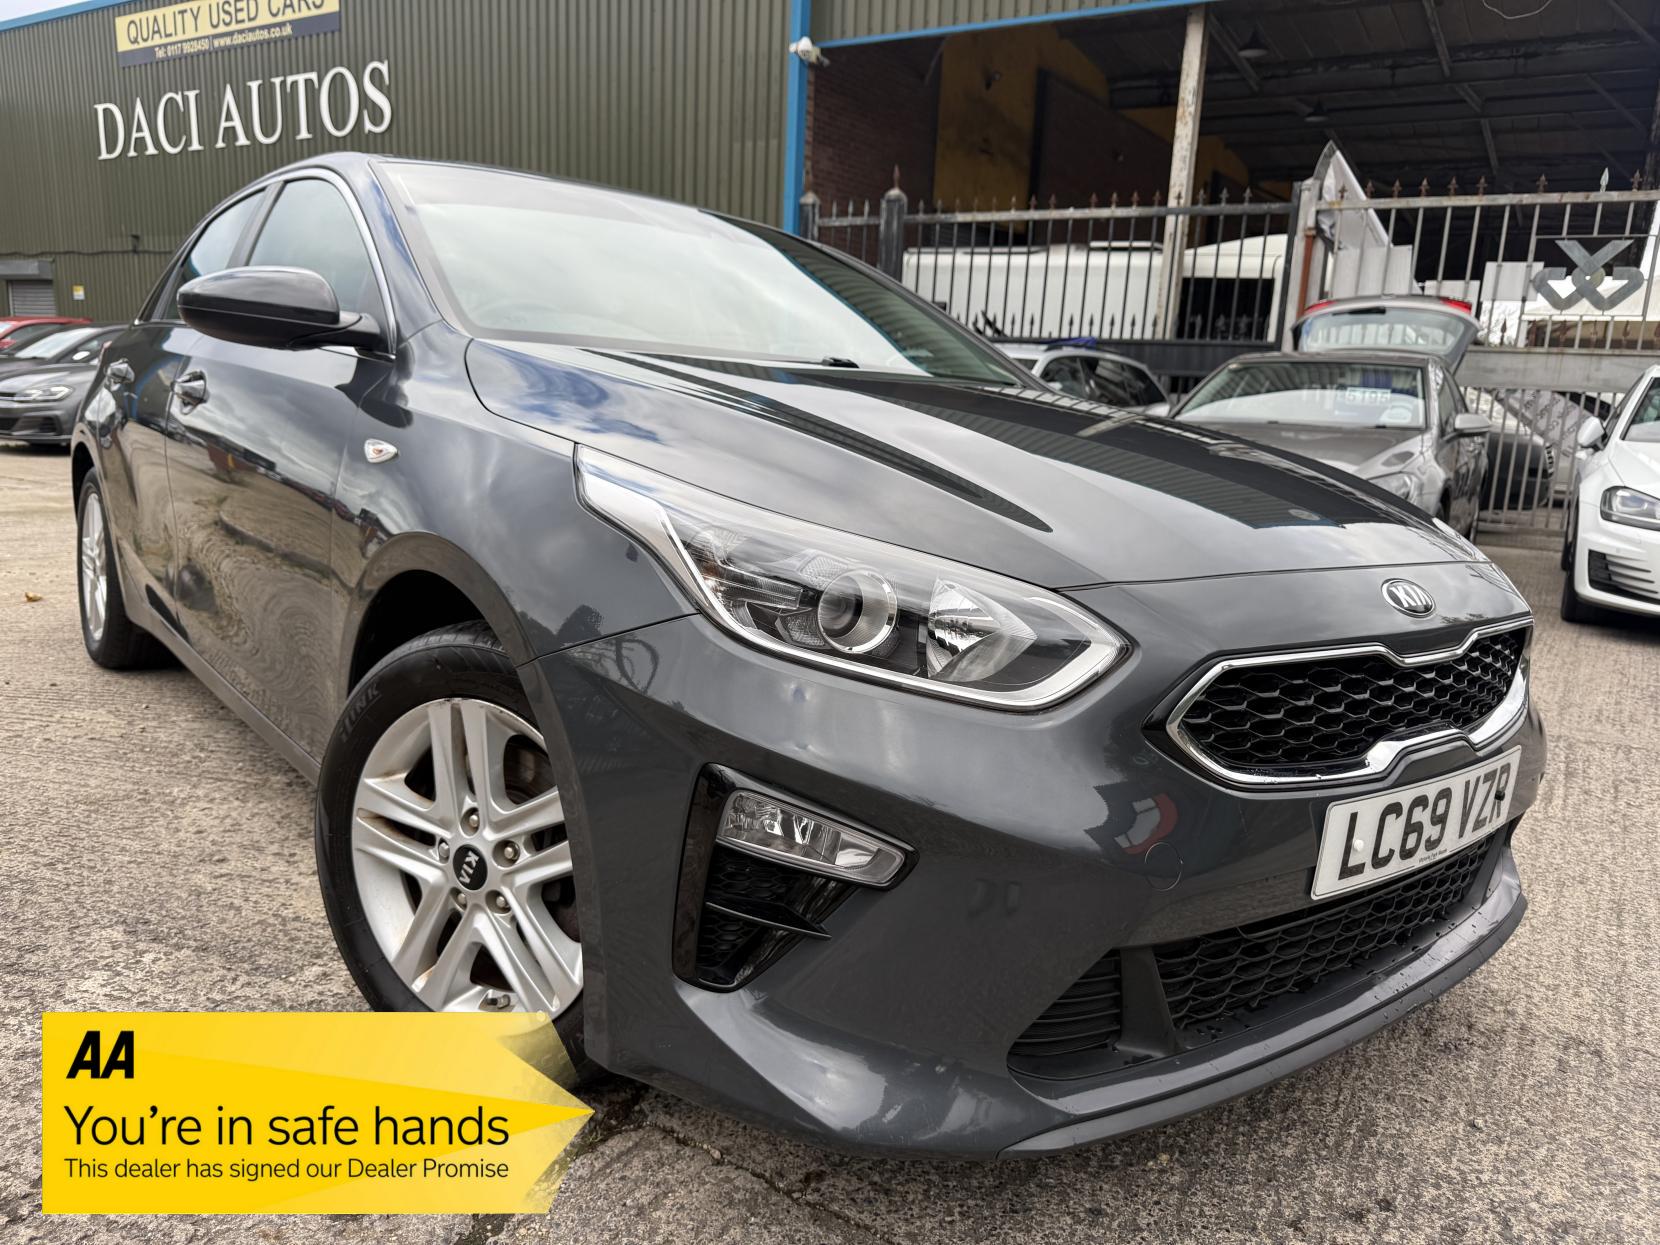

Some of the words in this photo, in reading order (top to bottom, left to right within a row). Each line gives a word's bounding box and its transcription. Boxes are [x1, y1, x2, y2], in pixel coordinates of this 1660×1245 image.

[126, 6, 201, 45] QUALITY
[208, 0, 259, 29] USED
[213, 22, 293, 47] www.daciautos.co.uk
[94, 90, 204, 160] DACI
[215, 60, 392, 149] AUTOS
[1388, 584, 1432, 608] KIA
[1338, 787, 1453, 881] LC69
[1458, 762, 1511, 839] VZR
[458, 850, 480, 884] KIA
